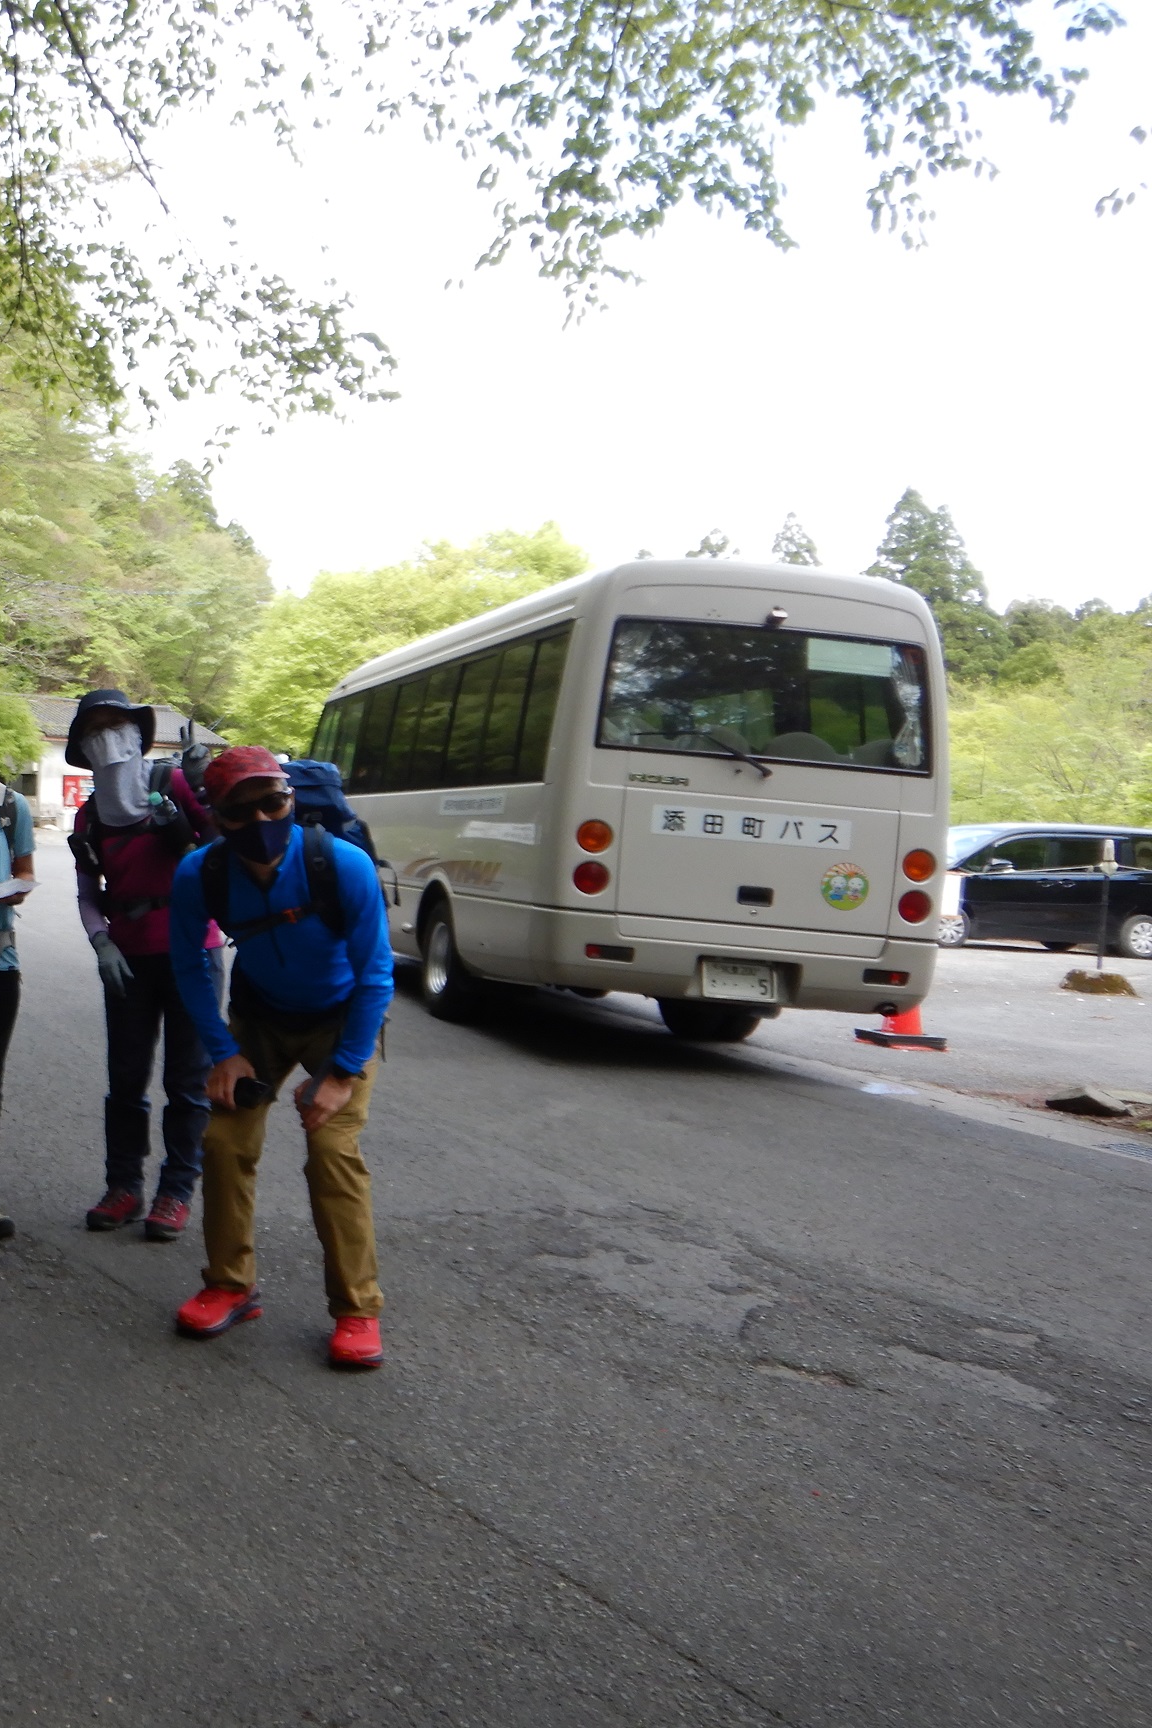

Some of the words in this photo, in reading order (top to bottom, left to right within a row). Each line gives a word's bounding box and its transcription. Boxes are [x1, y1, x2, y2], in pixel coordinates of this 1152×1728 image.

[662, 809, 840, 845] 添田町バス
